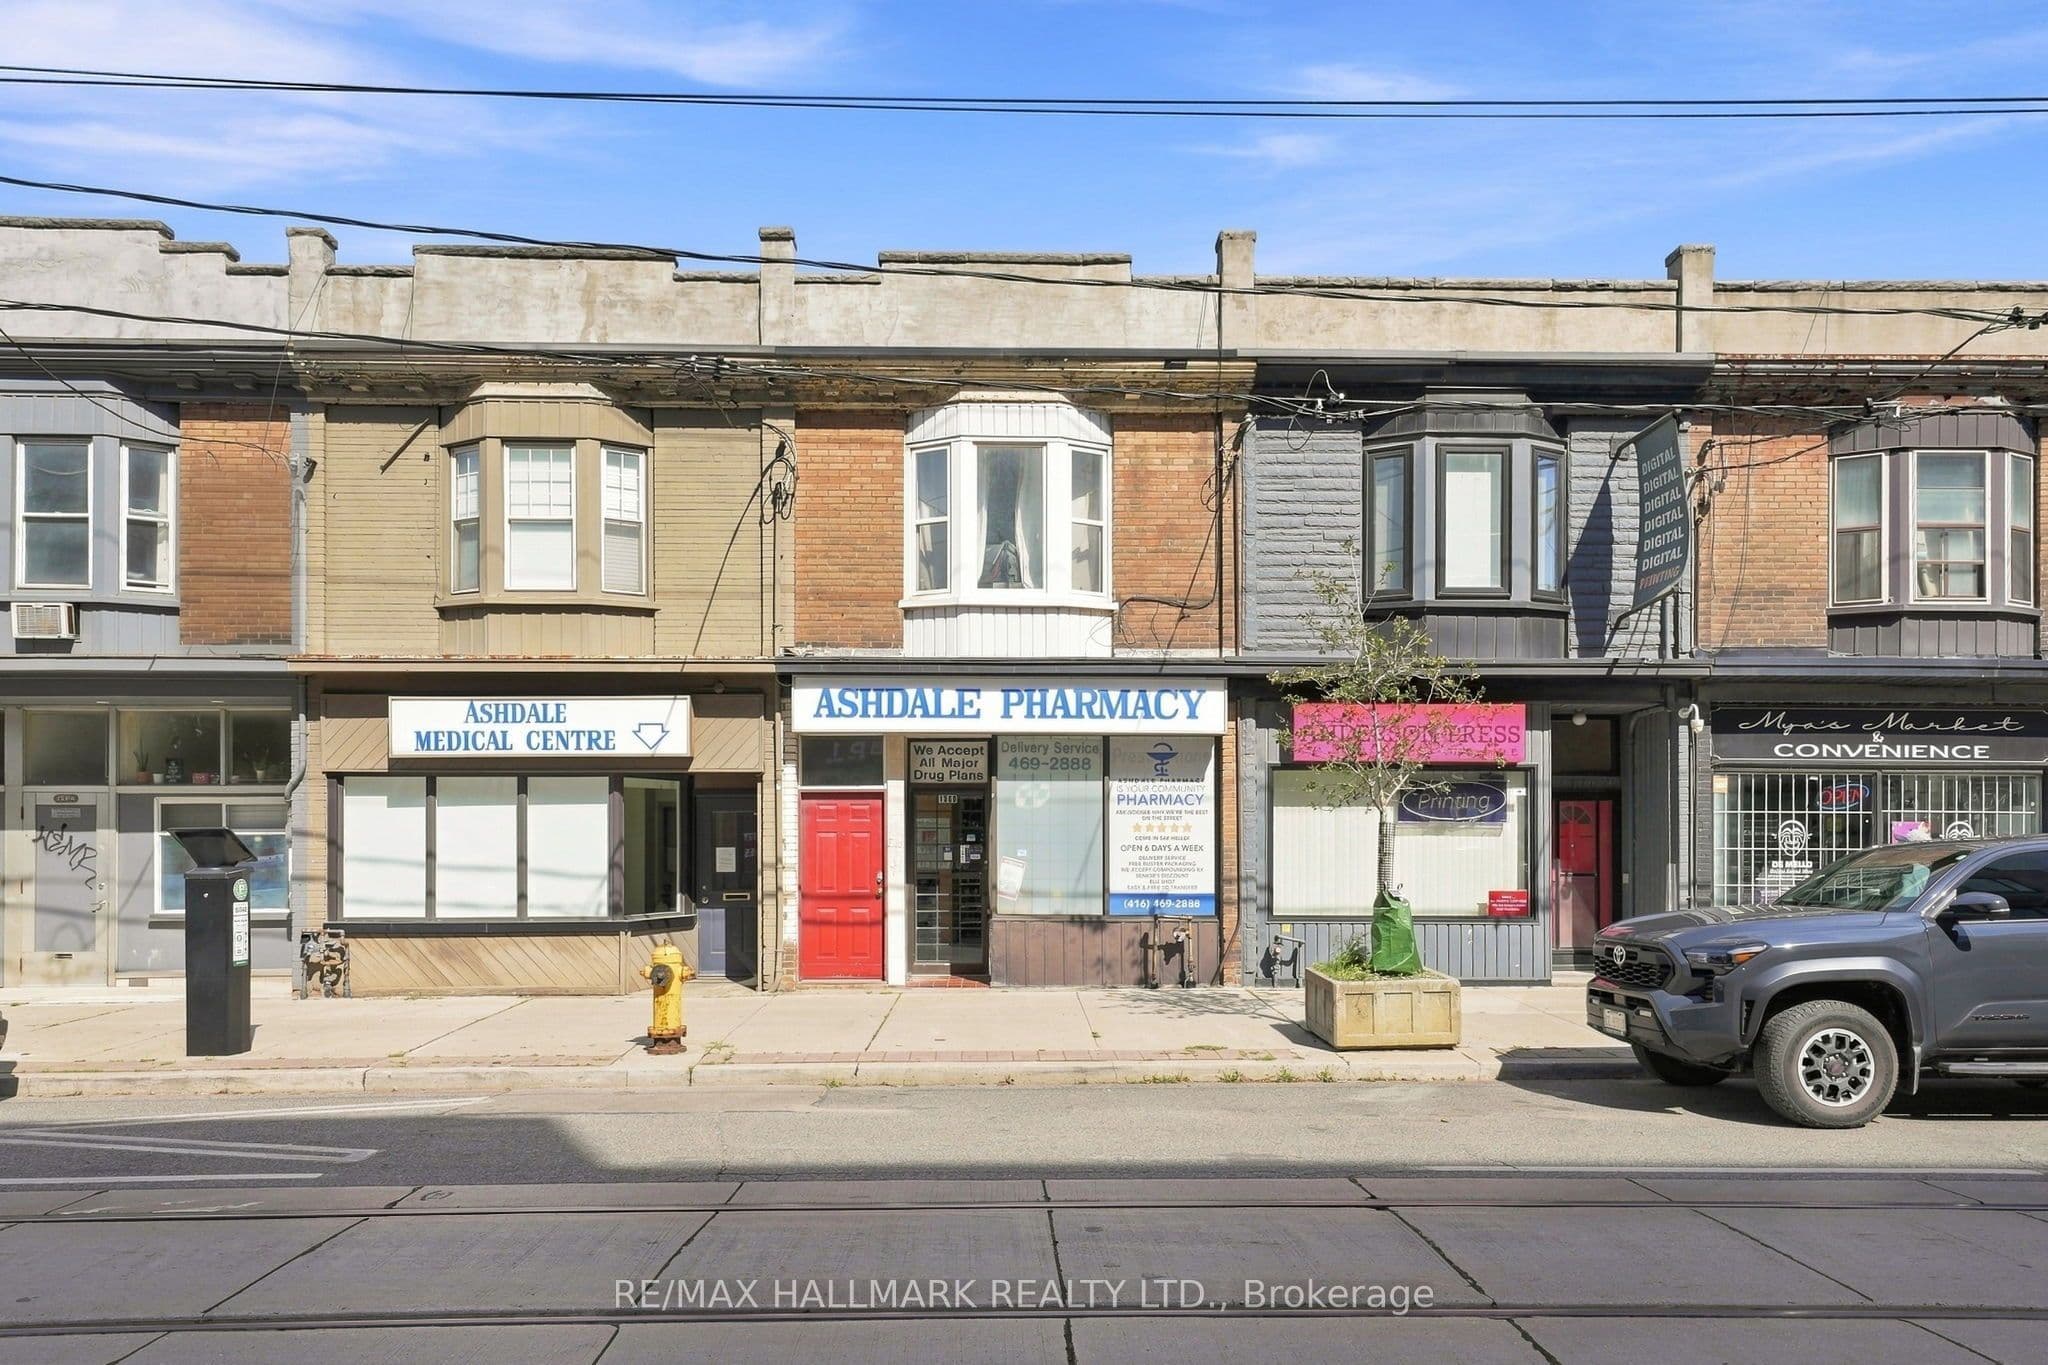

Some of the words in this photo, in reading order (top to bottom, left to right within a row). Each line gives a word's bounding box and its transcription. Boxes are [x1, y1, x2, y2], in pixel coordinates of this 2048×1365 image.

[1642, 446, 1676, 476] DIGITAL
[1643, 466, 1679, 495] DIGITAL
[1644, 486, 1682, 514] DIGITAL
[1644, 506, 1684, 533] DIGITAL
[1643, 526, 1684, 552] DIGITAL
[1642, 546, 1683, 572] DIGITAL
[1639, 565, 1681, 590] PRINTING
[464, 700, 567, 724] ASHDALE
[813, 688, 981, 719] ASHDALE
[1000, 688, 1206, 720] PHARMACY
[1862, 712, 2025, 732] Market
[414, 730, 513, 752] MEDICAL
[526, 730, 616, 751] CENTRE
[1448, 725, 1521, 744] PRESS
[1872, 731, 1884, 743] &
[913, 745, 934, 756] We
[937, 745, 985, 758] Accept
[1001, 742, 1049, 756] Delivery
[1053, 742, 1099, 754] Service
[1773, 743, 1990, 759] CONVENIENCE
[919, 758, 935, 768] All
[941, 758, 978, 769] Major
[1008, 757, 1092, 771] 469-2888
[914, 770, 945, 781] Drug
[949, 770, 984, 781] Plans
[1126, 785, 1149, 793] YOUR
[1151, 785, 1206, 793] COMMUNITY
[1821, 786, 1865, 805] OPEN
[1117, 794, 1204, 805] PHARMACY
[1418, 793, 1490, 813] Printing
[1771, 860, 1784, 868] DE
[1785, 860, 1813, 868] MELLO
[1123, 899, 1150, 909] (416)
[1152, 899, 1201, 909] 469-2888
